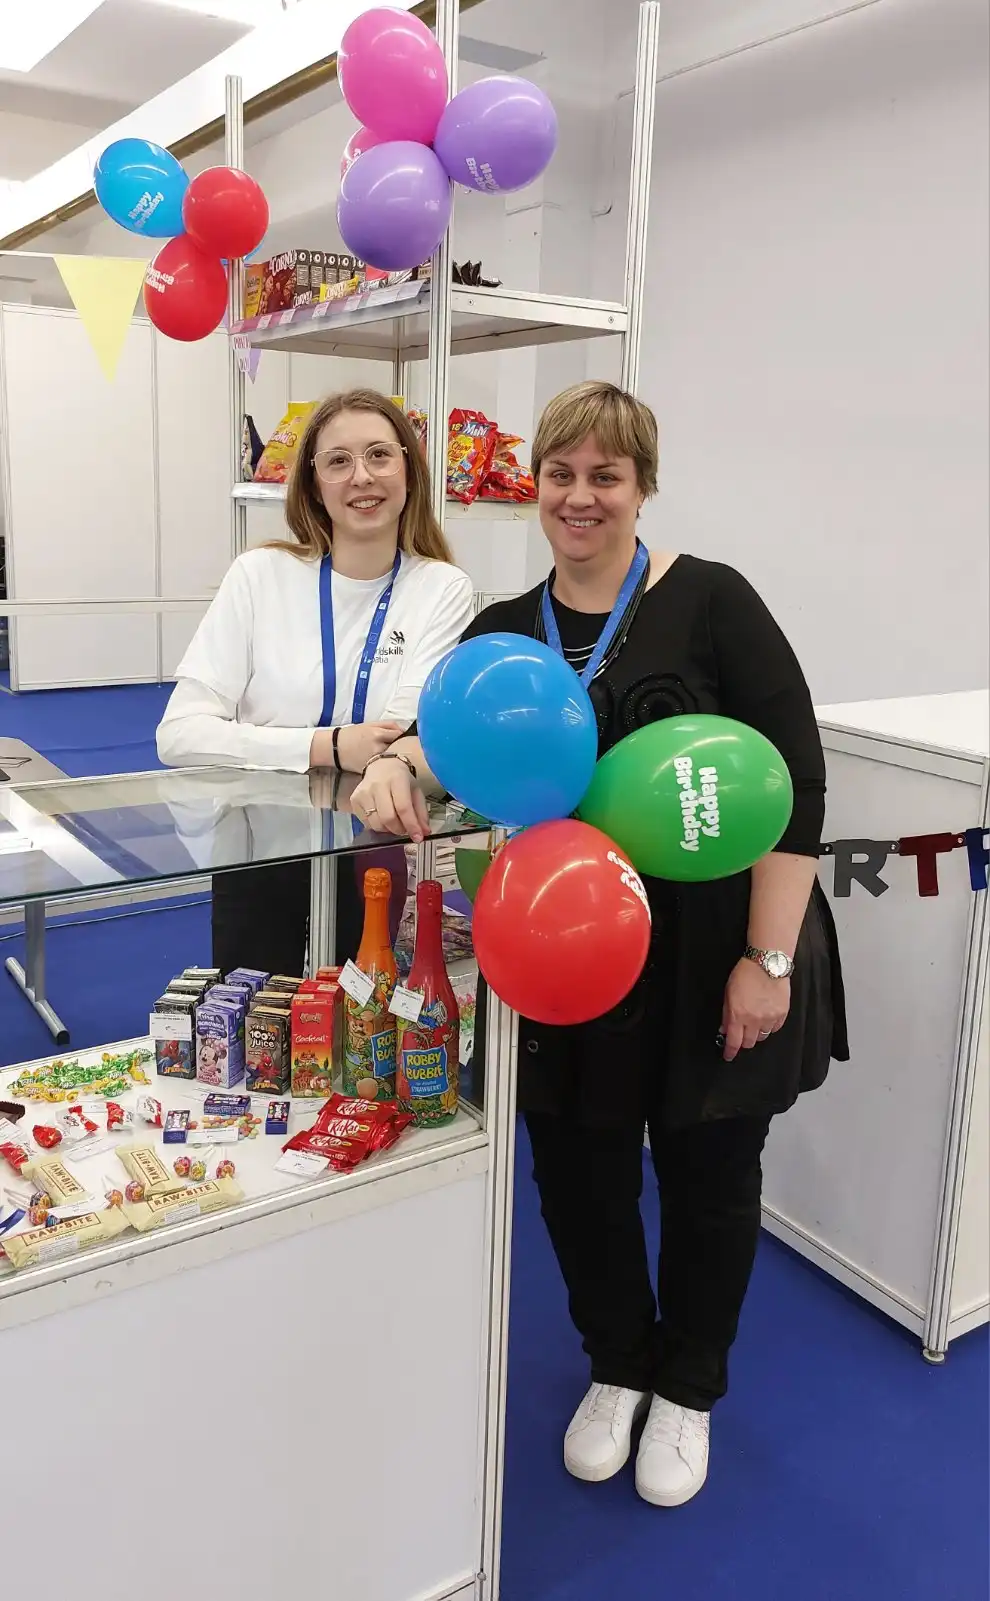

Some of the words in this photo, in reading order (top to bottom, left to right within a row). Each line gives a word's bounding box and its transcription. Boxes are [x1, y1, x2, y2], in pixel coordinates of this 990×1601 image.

[673, 756, 702, 852] Birthday
[698, 766, 721, 838] Happy
[249, 1030, 276, 1041] 100%
[251, 1038, 275, 1048] juice
[406, 1051, 442, 1067] ROBBY
[406, 1064, 444, 1080] BUBBLE
[328, 1119, 359, 1136] KitKat
